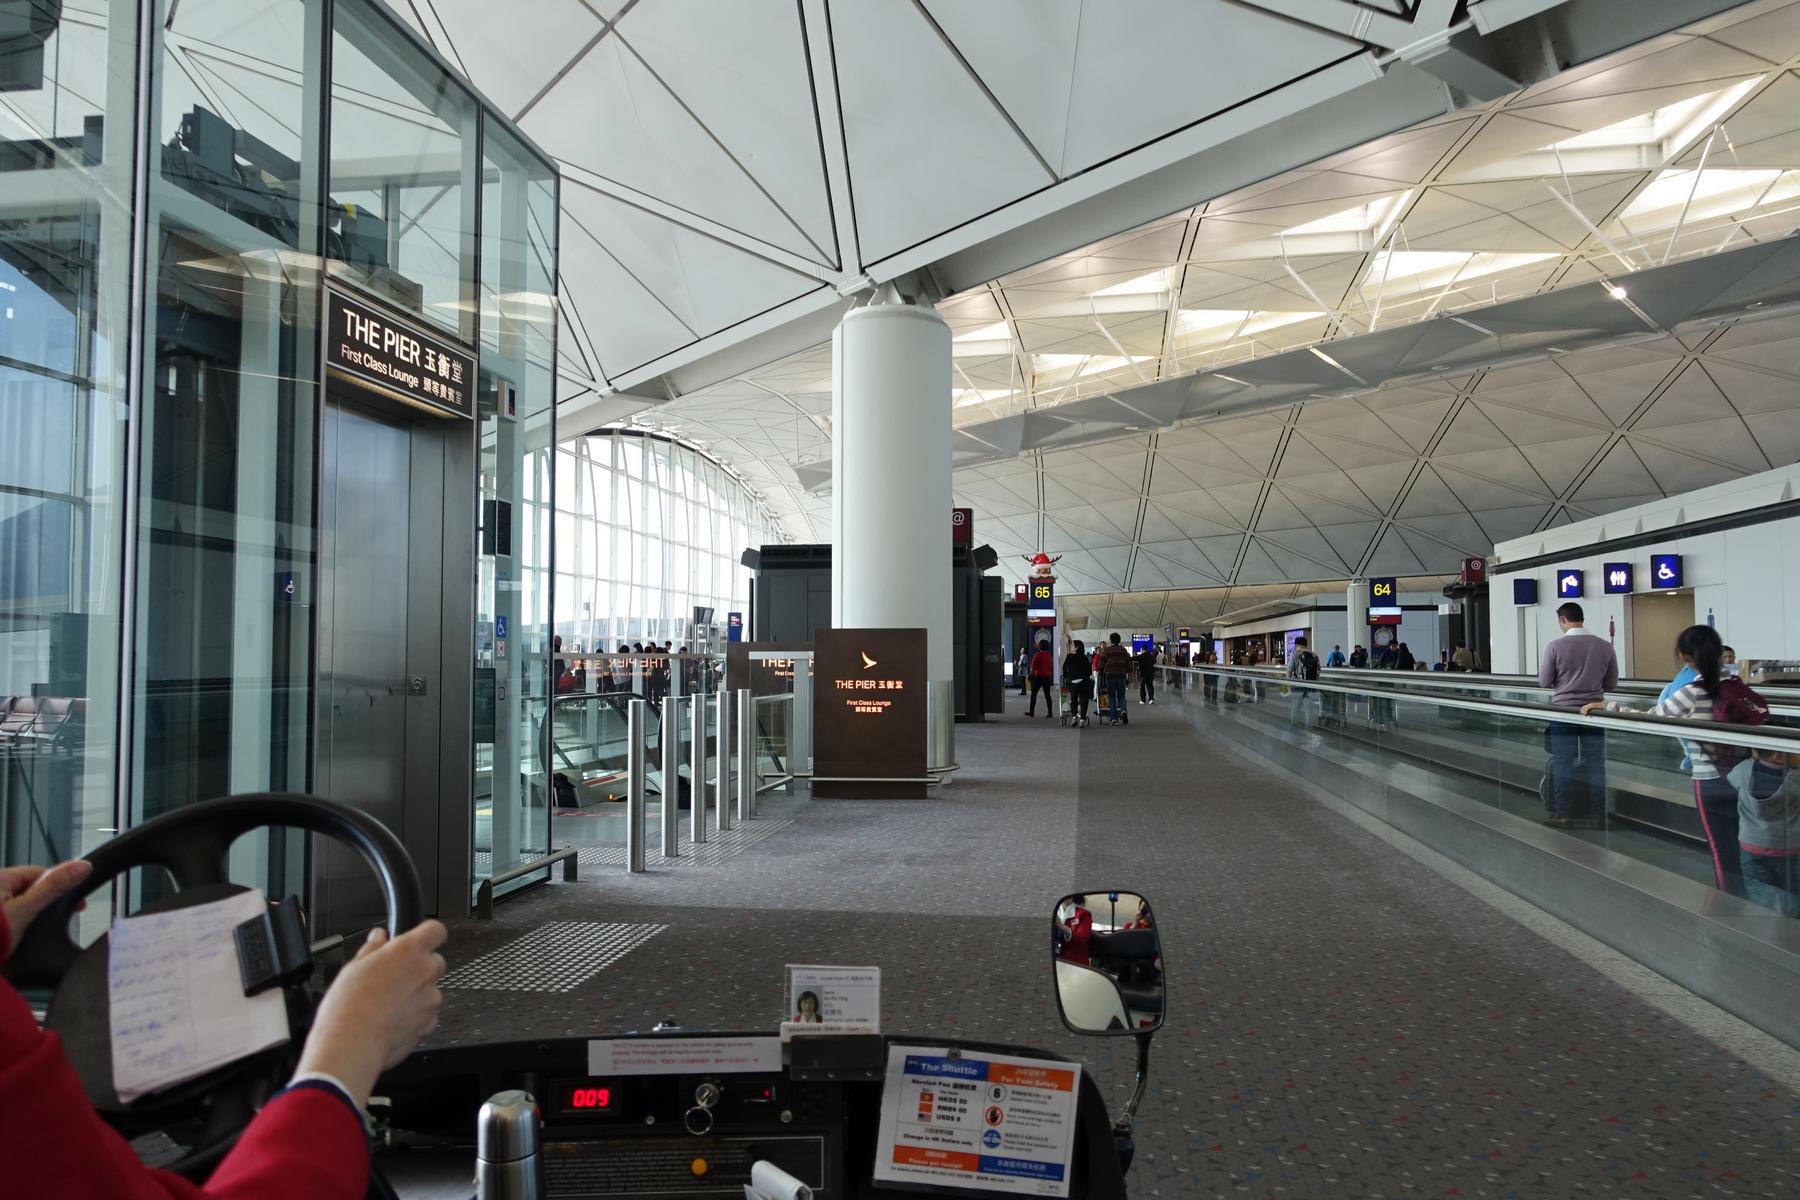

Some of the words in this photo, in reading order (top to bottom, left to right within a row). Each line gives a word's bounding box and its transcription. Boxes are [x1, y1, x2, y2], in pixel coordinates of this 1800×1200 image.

[343, 308, 380, 349] THE
[384, 327, 420, 367] PIER
[424, 347, 463, 384] 玉衡堂
[341, 343, 362, 365] First
[363, 353, 388, 375] Class
[388, 363, 418, 388] Lounge
[1035, 586, 1050, 598] 65
[1374, 583, 1391, 596] 64
[835, 680, 854, 689] THE
[855, 680, 876, 689] PIER
[872, 699, 891, 707] Lounge
[921, 1063, 939, 1072] The
[942, 1063, 978, 1075] Shuttle
[573, 1089, 609, 1107] 009
[993, 1087, 1001, 1099] 6
